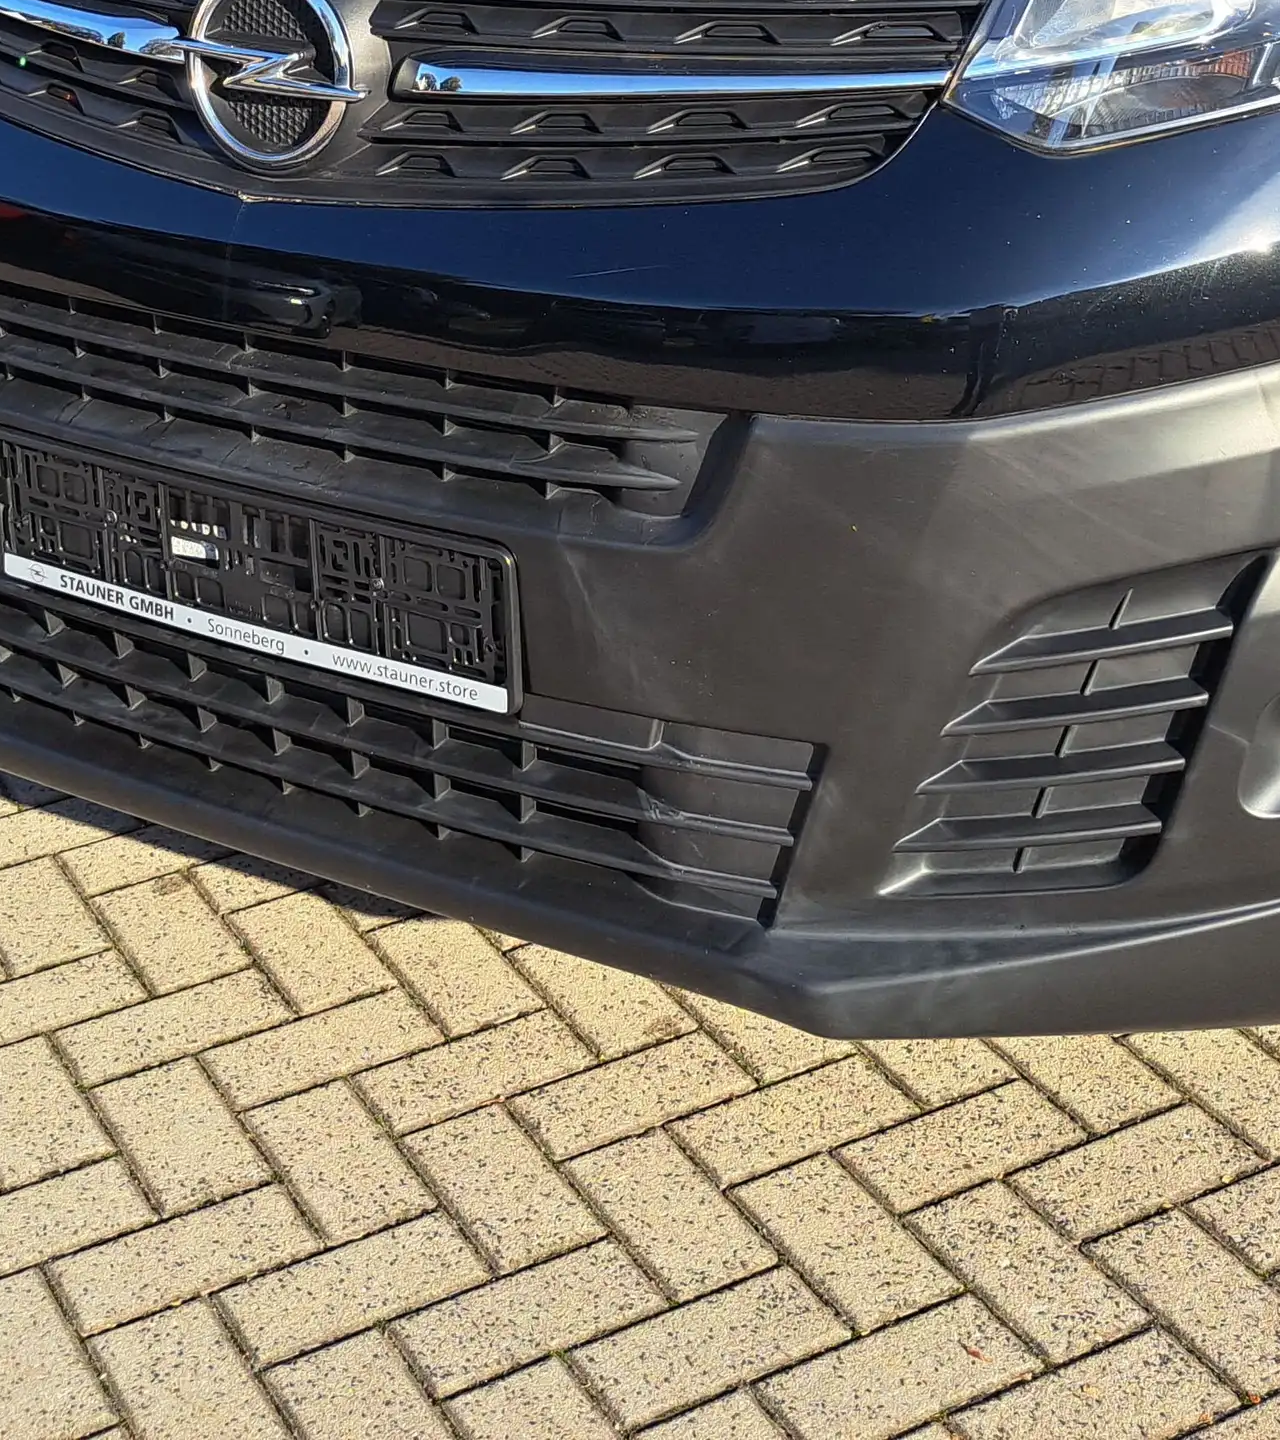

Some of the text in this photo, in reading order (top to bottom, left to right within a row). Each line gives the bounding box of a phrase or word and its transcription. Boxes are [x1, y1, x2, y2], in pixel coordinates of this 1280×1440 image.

[60, 574, 479, 702] STAUNER GMBH Sonneberg www.stauner.store
